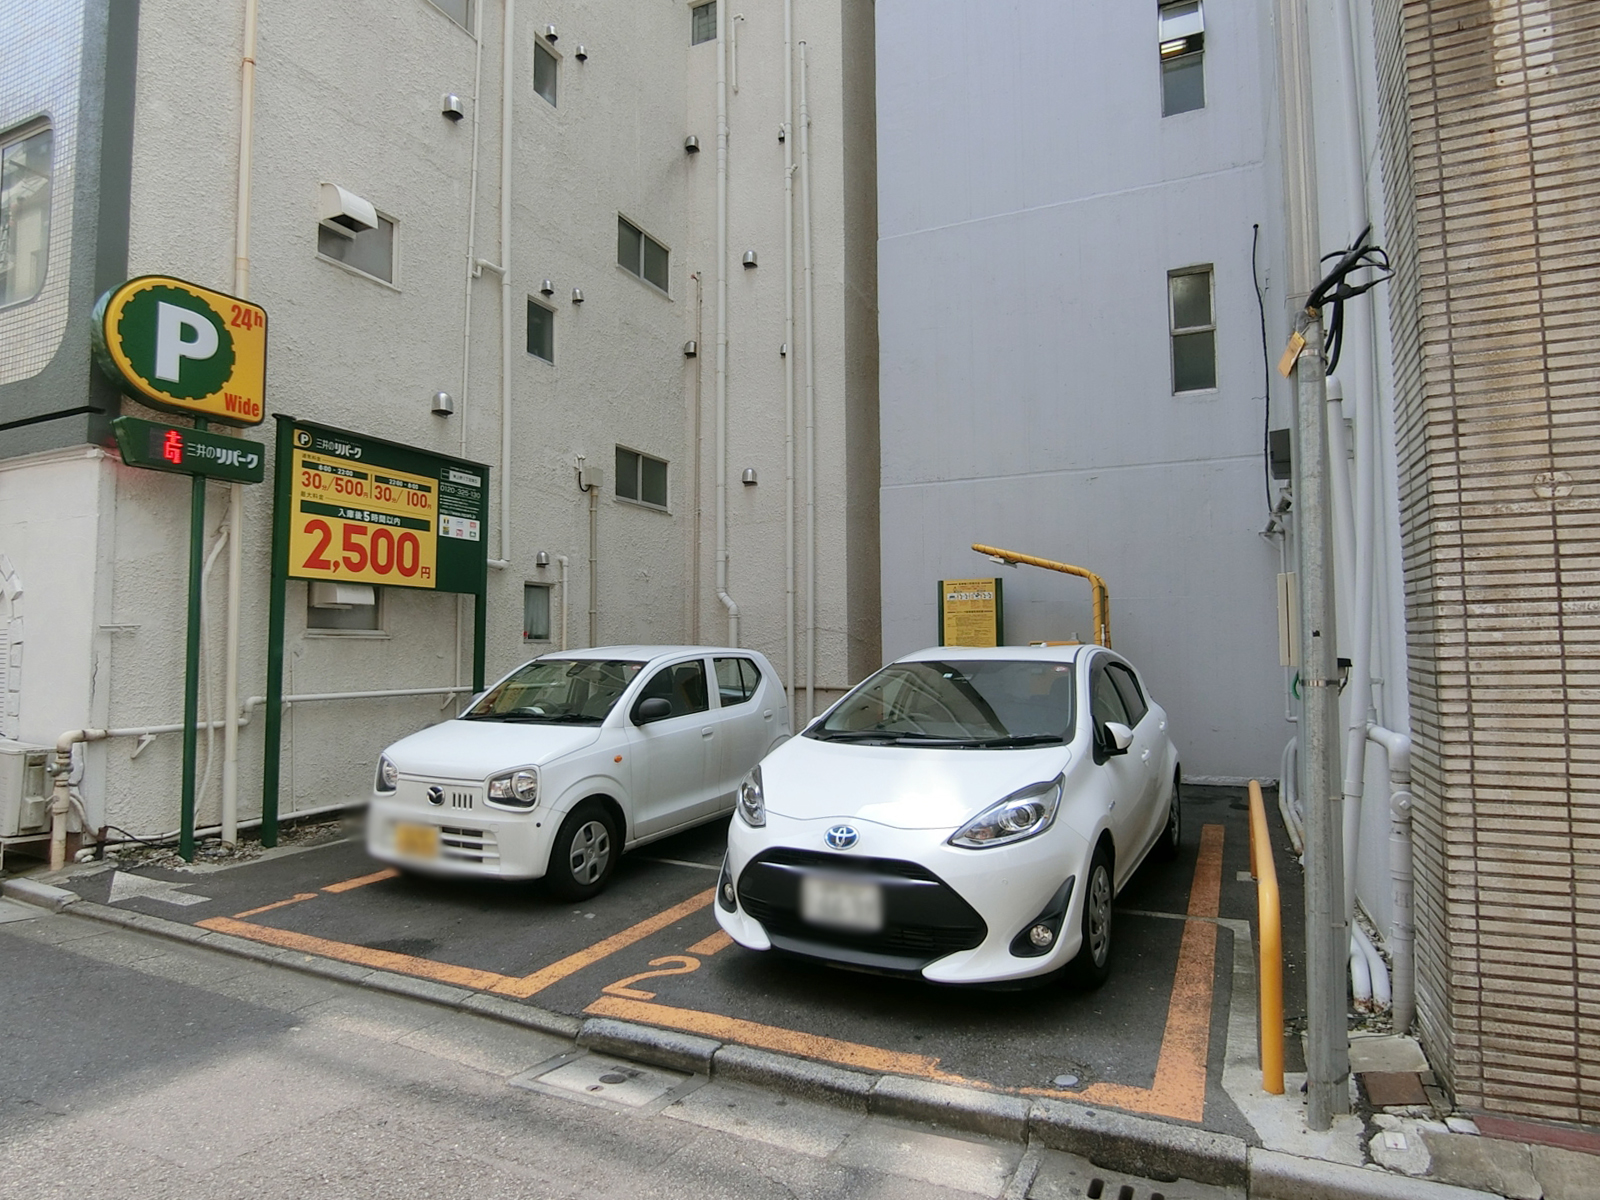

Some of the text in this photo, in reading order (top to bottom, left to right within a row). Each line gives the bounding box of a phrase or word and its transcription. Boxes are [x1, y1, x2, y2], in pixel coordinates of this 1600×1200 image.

[230, 304, 263, 331] 24h
[155, 301, 219, 383] P
[224, 392, 260, 417] Wide
[186, 442, 259, 469] 三井のリパーク
[316, 438, 362, 458] 三井のリパーク
[337, 507, 401, 527] 入庫後5時間以内
[302, 518, 431, 580] 2,500円
[601, 955, 701, 1000] 2
